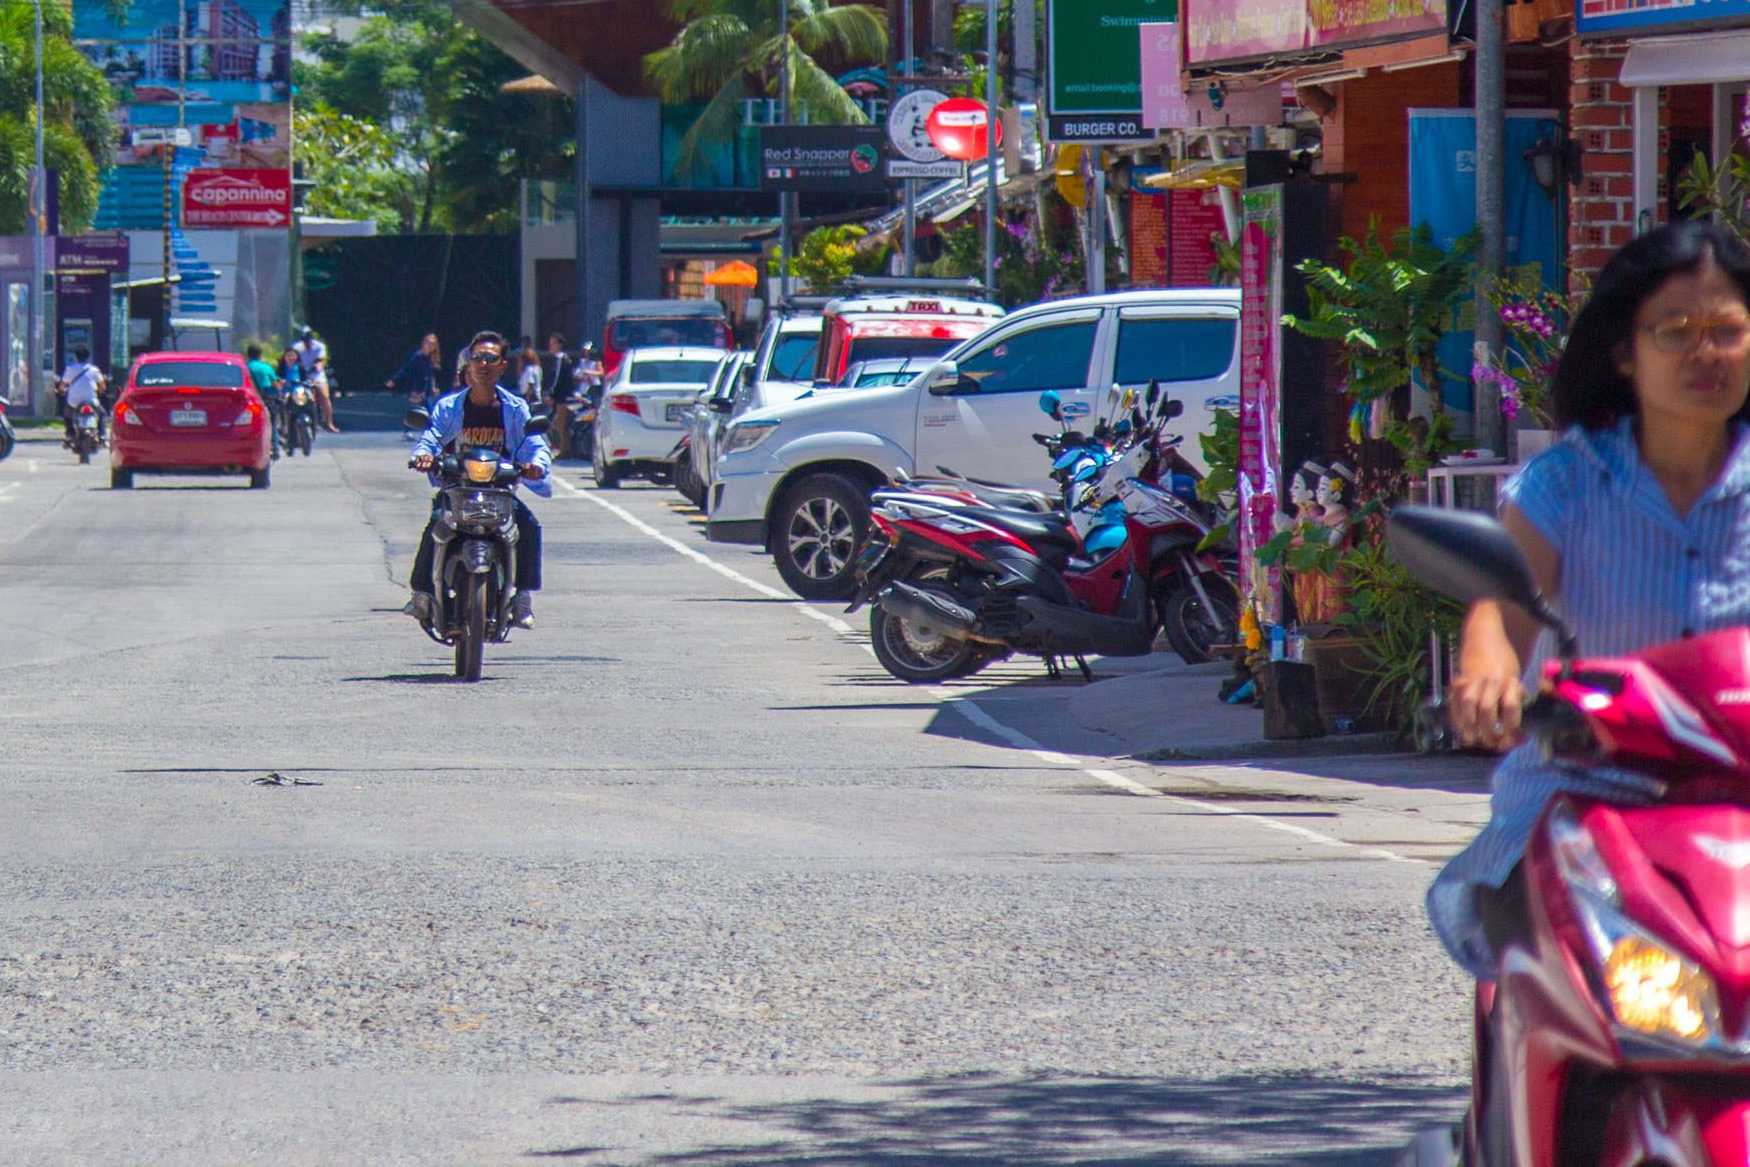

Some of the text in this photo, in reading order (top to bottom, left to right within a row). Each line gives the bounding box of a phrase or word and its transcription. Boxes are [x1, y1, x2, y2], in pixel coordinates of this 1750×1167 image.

[1064, 123, 1140, 136] BURGER CO.
[765, 147, 850, 162] Red Snapper
[191, 187, 287, 206] capannina
